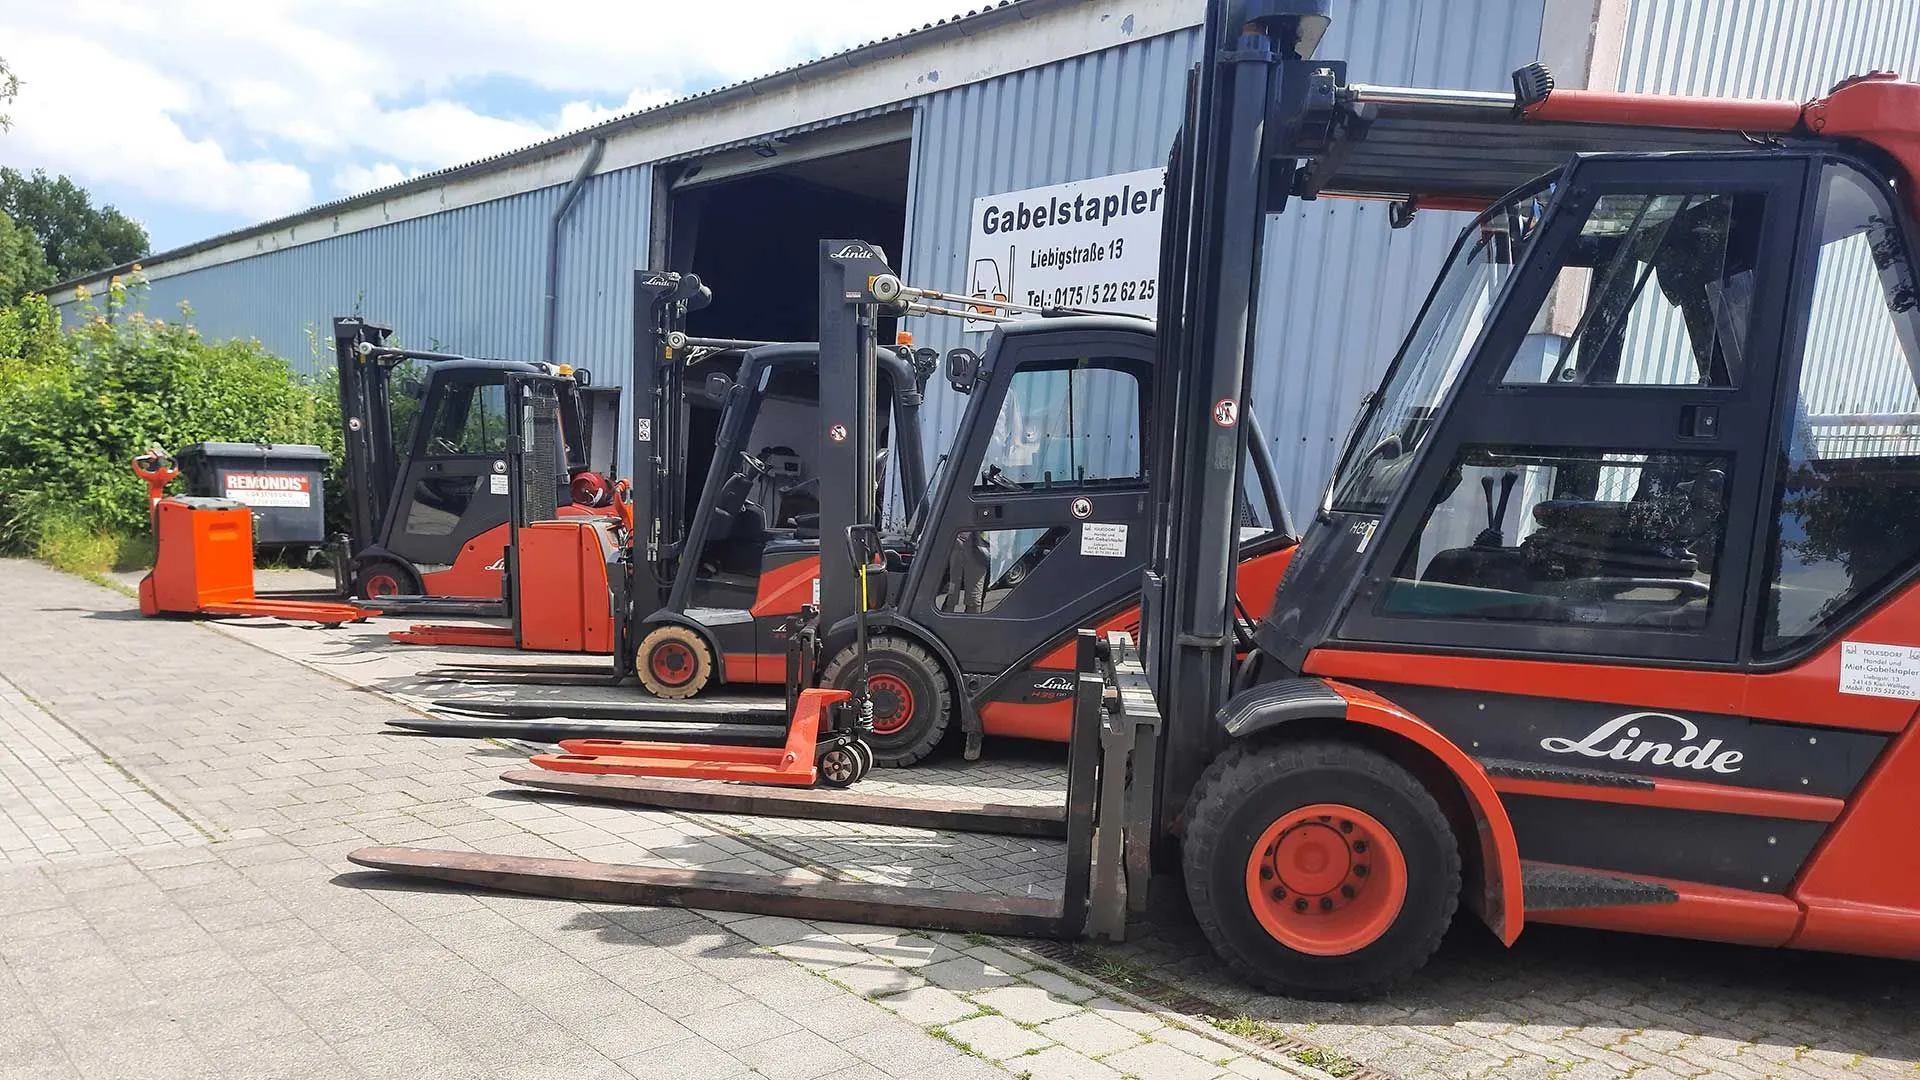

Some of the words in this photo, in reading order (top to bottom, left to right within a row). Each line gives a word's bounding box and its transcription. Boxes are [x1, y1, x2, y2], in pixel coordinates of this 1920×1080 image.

[983, 186, 1163, 234] Gabelstapler
[830, 245, 873, 259] Linde
[1031, 243, 1104, 270] Liebigstraße
[1109, 238, 1124, 260] 13
[1027, 290, 1051, 307] Tel.:
[1055, 286, 1083, 306] 0175
[1092, 285, 1099, 303] 5
[1102, 283, 1117, 303] 22
[1121, 281, 1136, 301] 62
[1139, 280, 1155, 300] 25
[1540, 712, 1744, 773] Linde
